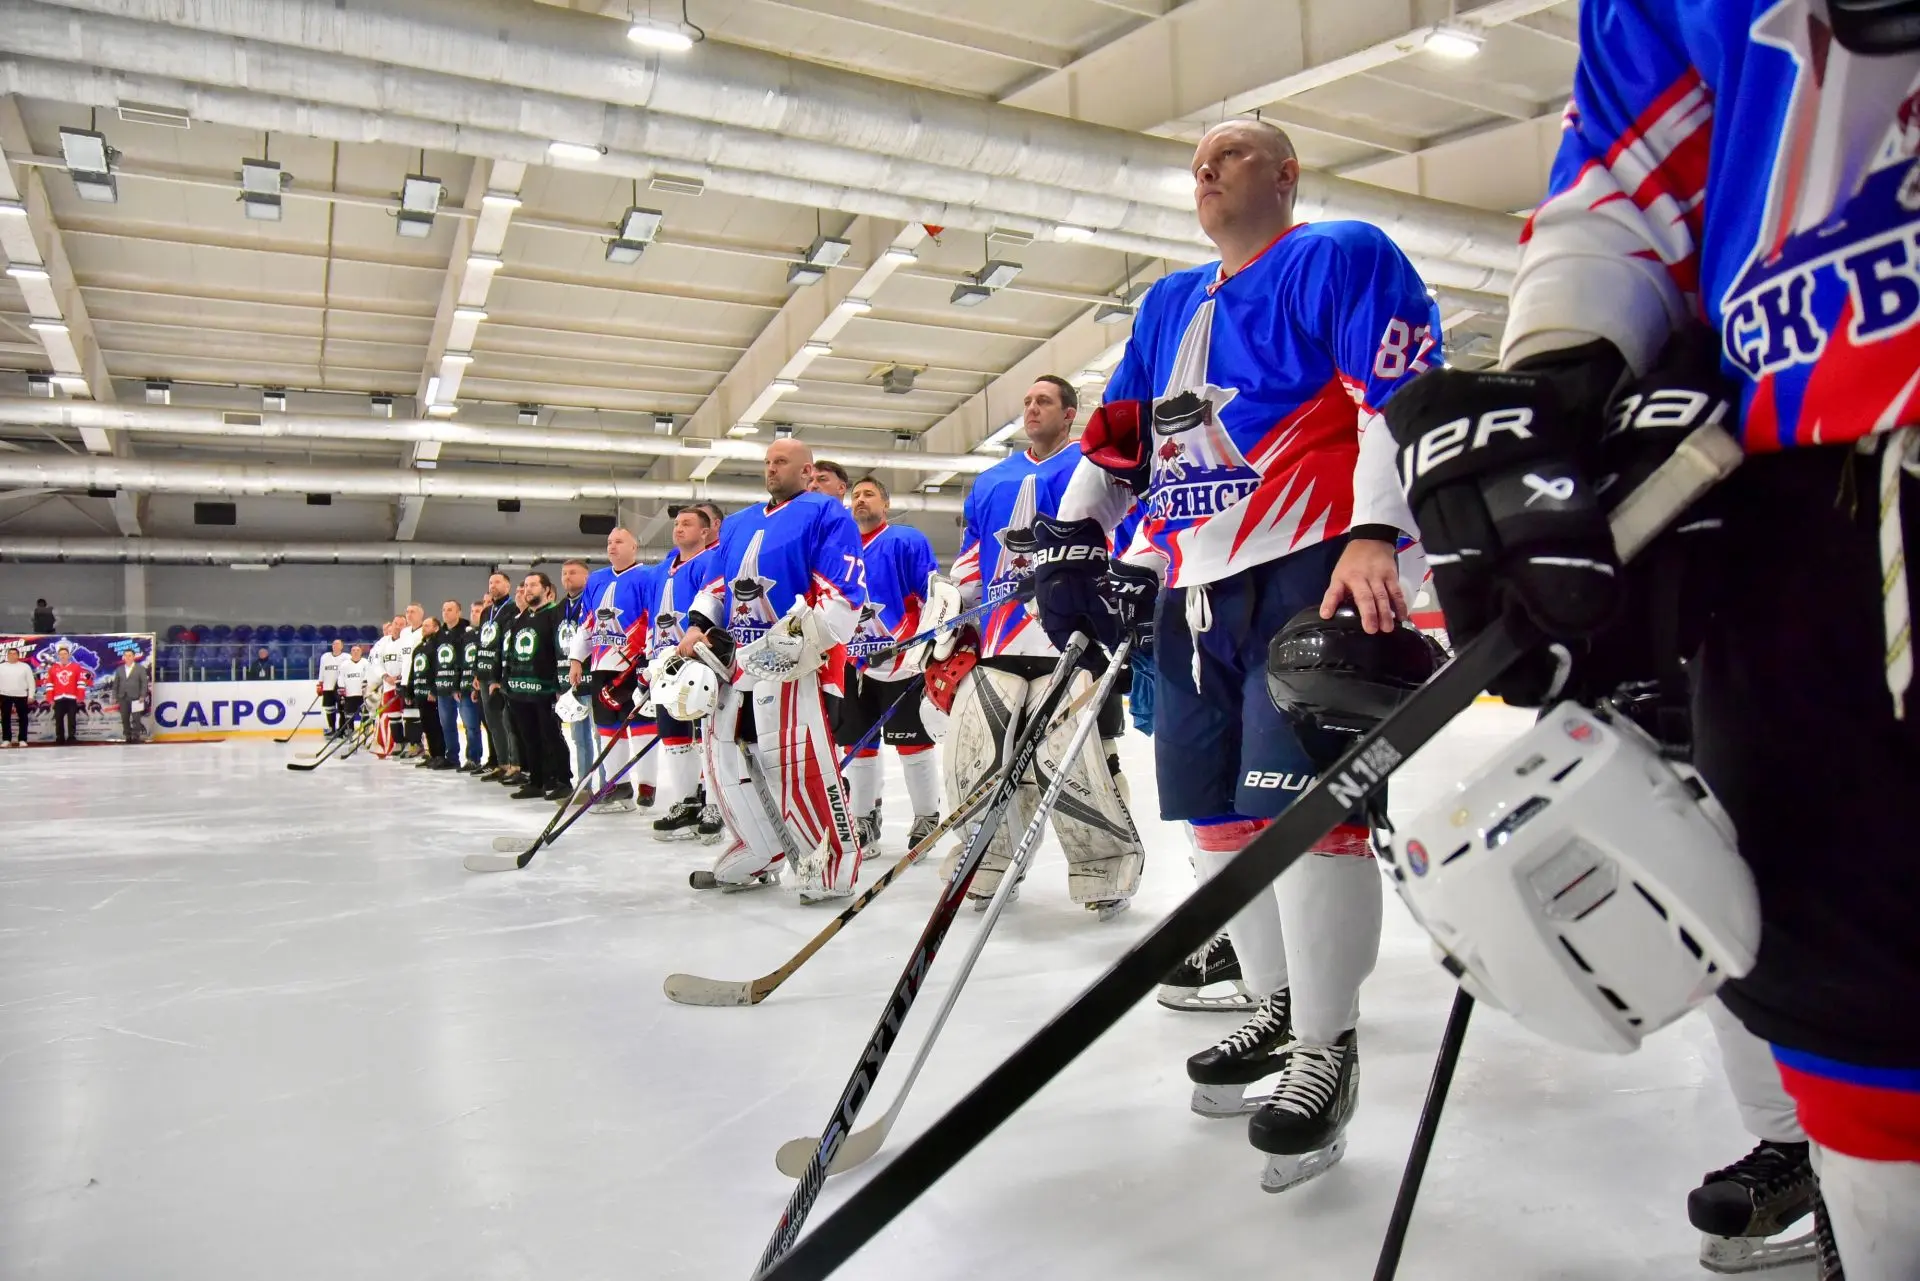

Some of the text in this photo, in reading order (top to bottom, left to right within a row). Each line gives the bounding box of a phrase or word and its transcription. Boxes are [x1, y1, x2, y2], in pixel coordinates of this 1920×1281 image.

[1726, 231, 1920, 376] СК Б
[1374, 318, 1435, 378] 82
[1606, 389, 1729, 434] BA
[843, 554, 867, 589] 72
[154, 699, 286, 728] САГРО
[1012, 740, 1035, 788] prime
[827, 783, 852, 843] VAUGHN
[819, 946, 933, 1176] SOYUZ
